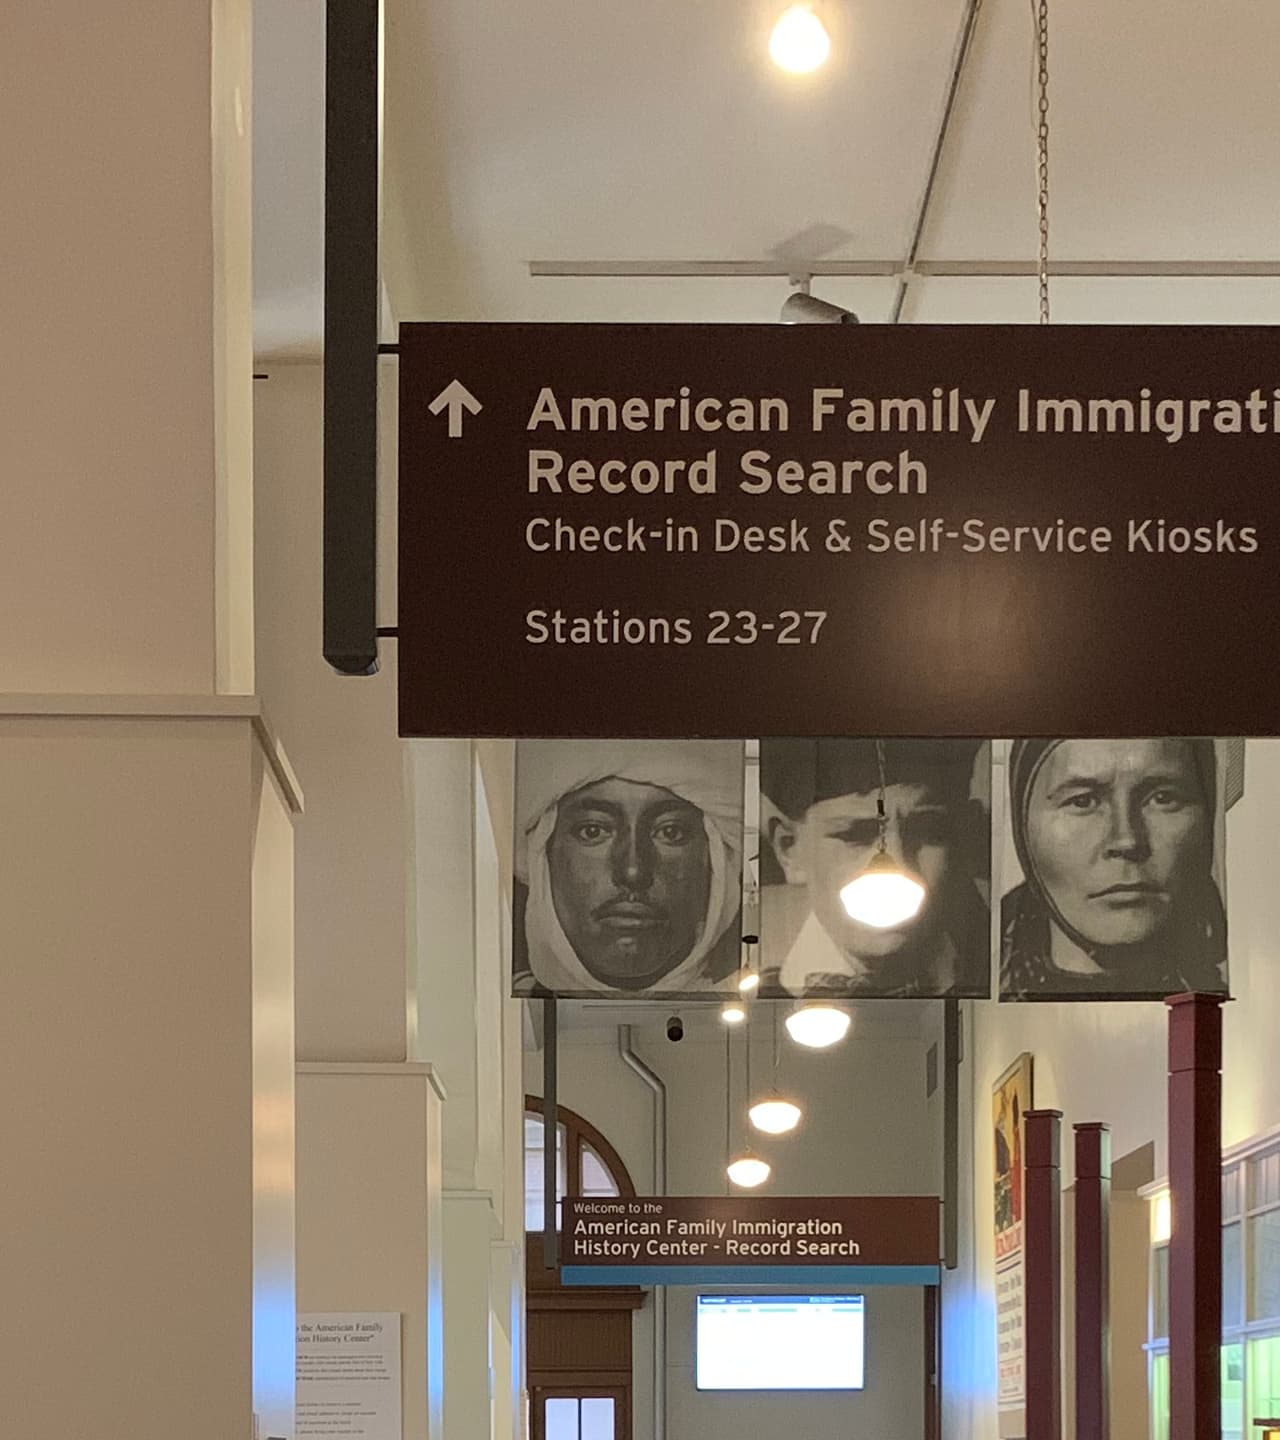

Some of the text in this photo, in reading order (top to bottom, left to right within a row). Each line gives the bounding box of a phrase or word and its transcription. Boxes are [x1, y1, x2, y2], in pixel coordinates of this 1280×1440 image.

[526, 386, 788, 433] American
[812, 387, 995, 443] Family
[527, 450, 927, 494] Record Search
[525, 517, 1259, 554] Check-in Desk & Self-Service Kiosks
[525, 611, 827, 645] Stations 23-27
[573, 1202, 664, 1215] Welcome to the
[573, 1219, 843, 1238] American Family Immigration
[573, 1239, 641, 1259] History
[646, 1239, 708, 1257] Center
[725, 1239, 790, 1257] Record
[796, 1239, 861, 1257] Search
[316, 1322, 354, 1332] American
[356, 1322, 383, 1333] Family
[312, 1334, 341, 1344] History
